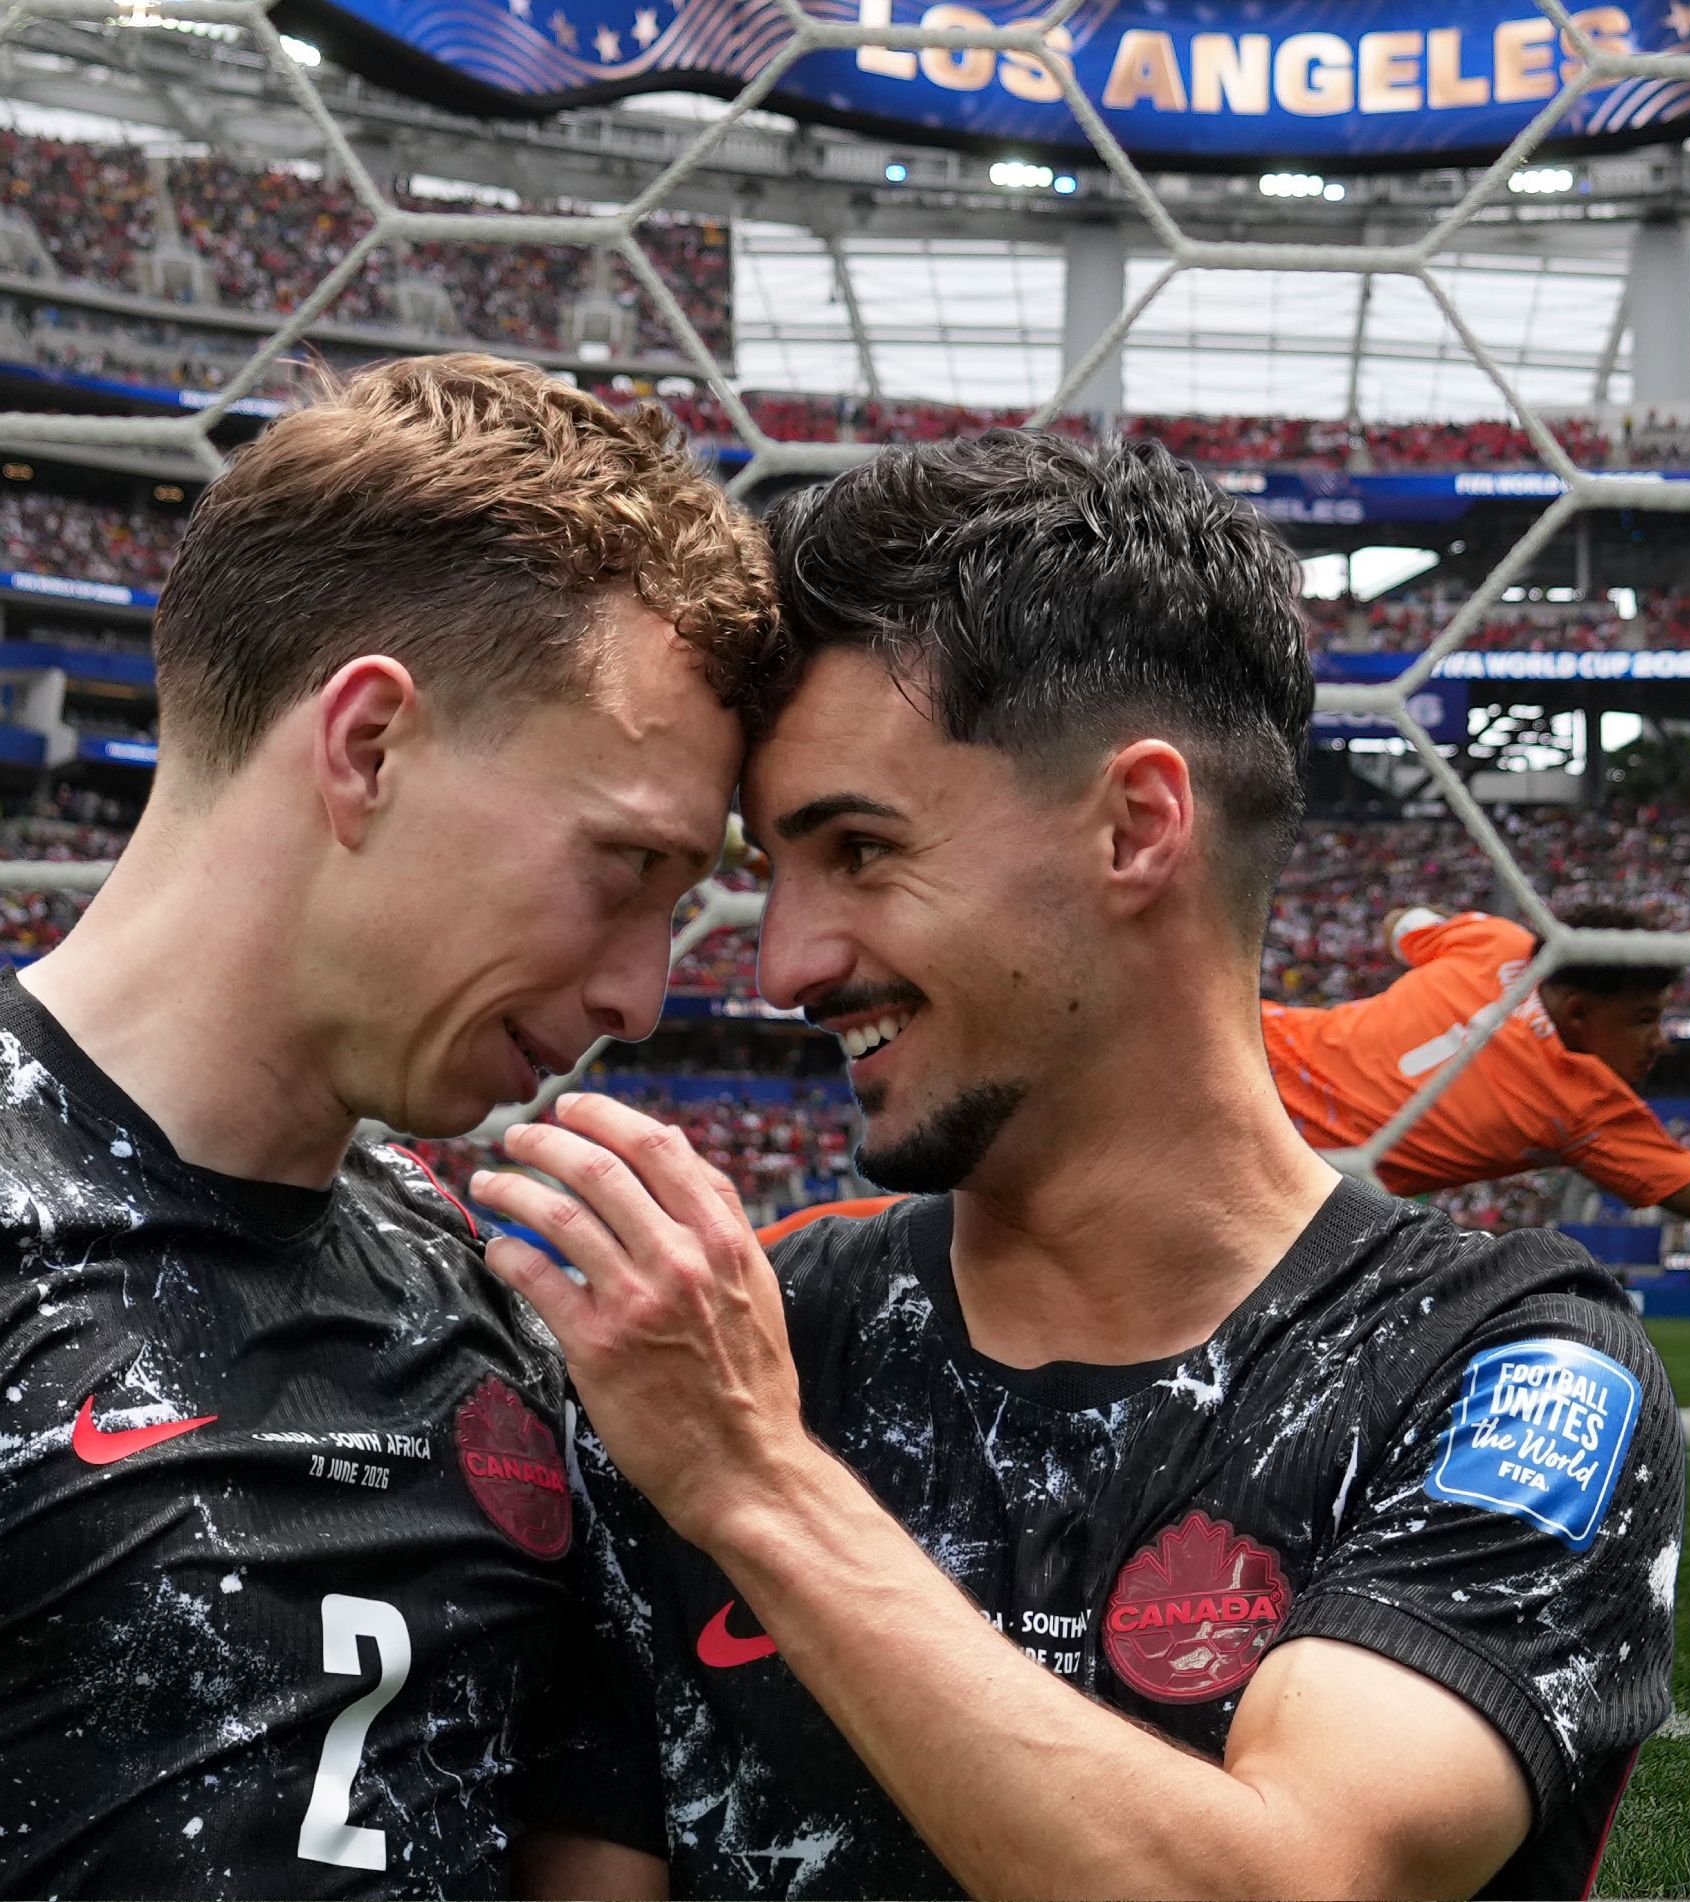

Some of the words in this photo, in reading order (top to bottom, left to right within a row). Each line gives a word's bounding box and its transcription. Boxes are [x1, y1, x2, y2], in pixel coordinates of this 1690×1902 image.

[855, 0, 1074, 104] LOS
[1103, 7, 1632, 116] ANGELES
[1500, 1362, 1609, 1416] FOOTBALL
[1489, 1384, 1605, 1452] UNITES
[328, 1432, 383, 1453] SOUTH
[385, 1433, 432, 1460] AFRICA
[1471, 1416, 1517, 1451] the
[1517, 1428, 1600, 1493] World
[308, 1454, 326, 1478] 28
[326, 1457, 359, 1485] JUNE
[360, 1465, 391, 1491] 2026
[465, 1450, 565, 1494] CANADA
[1498, 1460, 1549, 1492] FIFA
[1110, 1595, 1279, 1633] CANADA
[297, 1593, 412, 1872] 2
